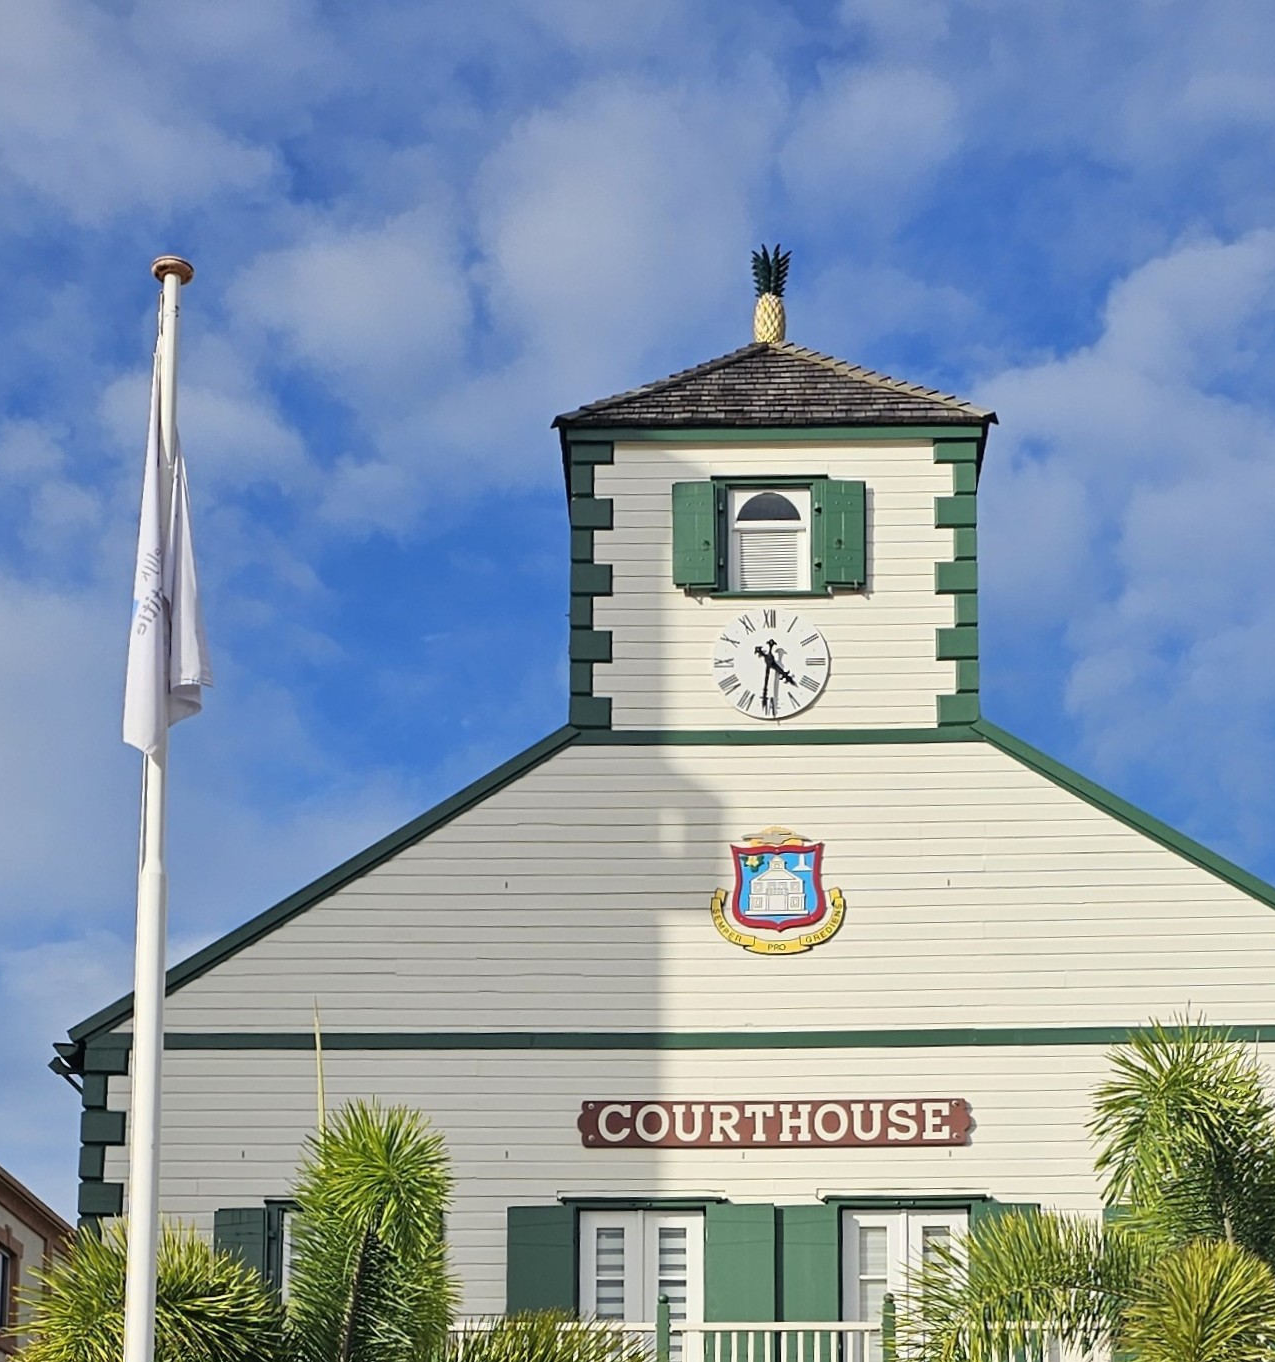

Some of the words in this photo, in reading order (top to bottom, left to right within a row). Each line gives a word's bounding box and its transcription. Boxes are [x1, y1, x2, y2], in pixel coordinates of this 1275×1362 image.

[763, 608, 776, 629] XII
[712, 908, 742, 943] SEMPER
[767, 943, 786, 951] PRO
[805, 903, 843, 943] GREDIENS
[597, 1102, 951, 1142] COURTHOUSE
